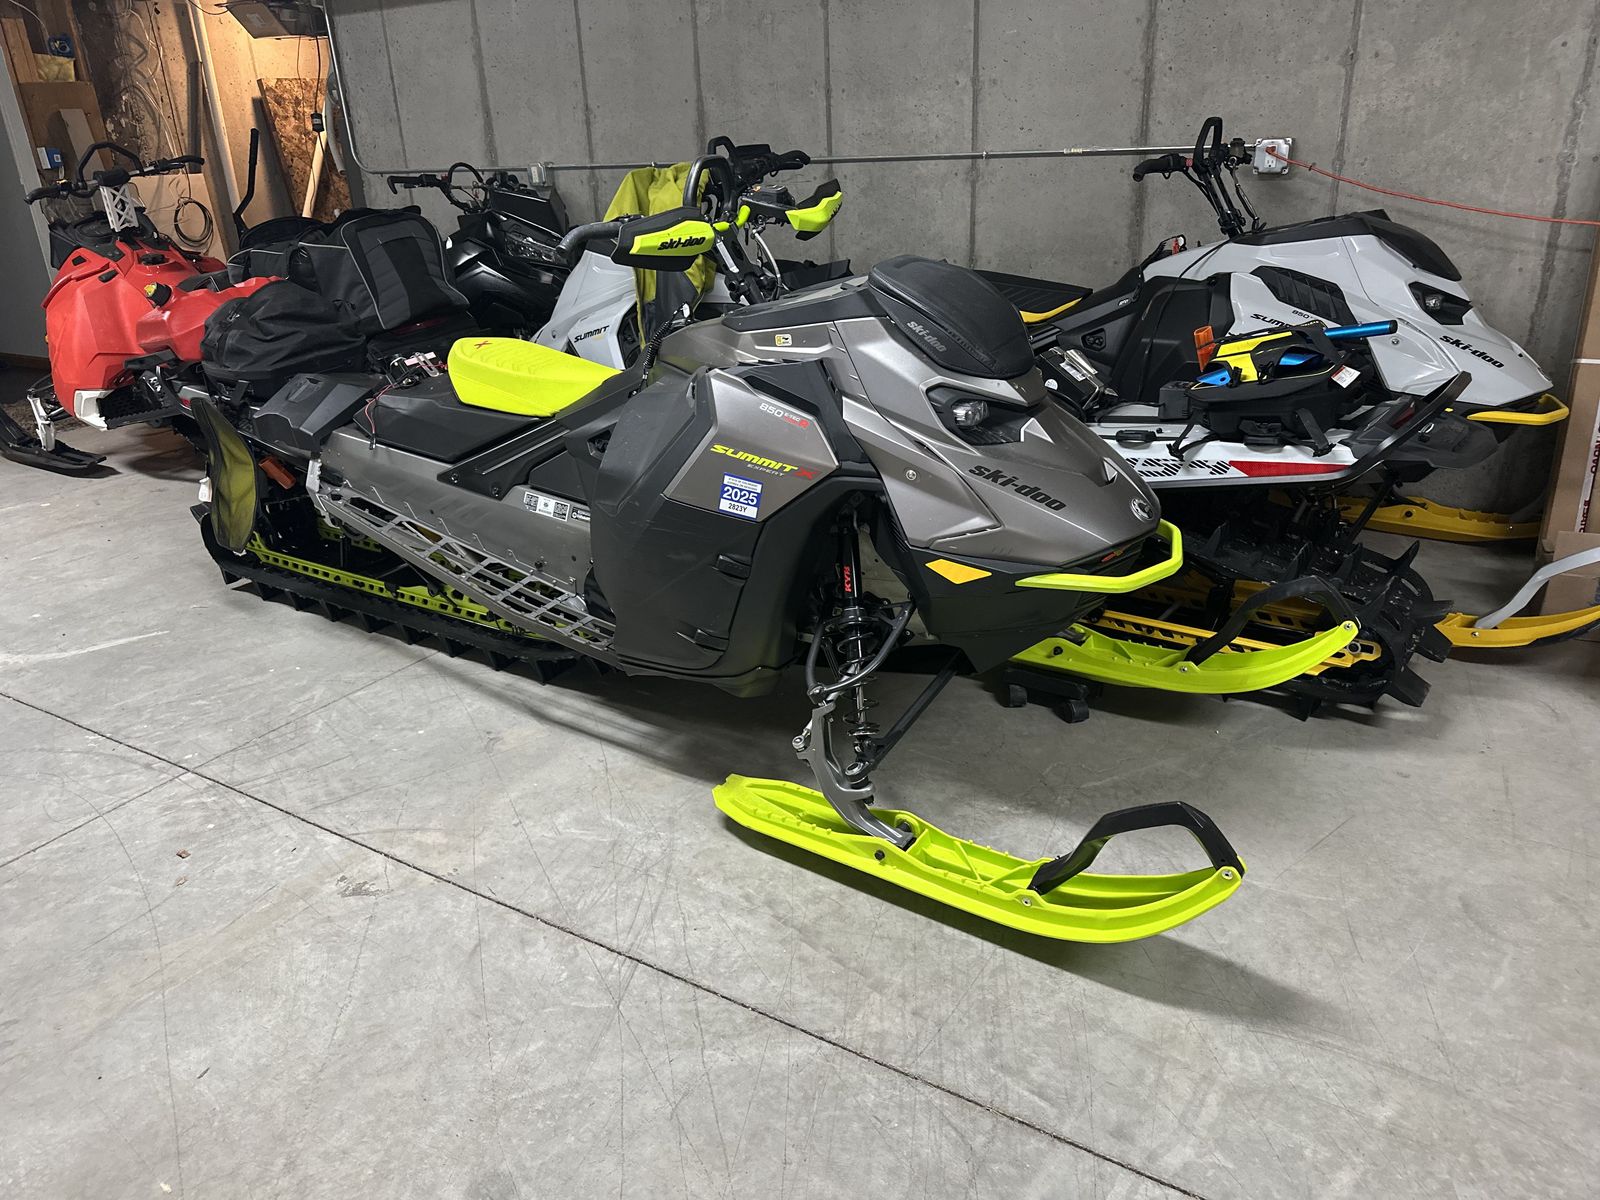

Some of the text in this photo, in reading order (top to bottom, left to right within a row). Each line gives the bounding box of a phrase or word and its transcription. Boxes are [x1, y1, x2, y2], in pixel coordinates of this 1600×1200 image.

[657, 236, 706, 251] ski-doo
[906, 321, 948, 353] ski-doo
[1439, 335, 1505, 369] ski-doo
[760, 402, 784, 418] 850
[710, 444, 799, 472] SUMMIT
[746, 463, 786, 477] EXPERT
[722, 486, 758, 506] 2025
[968, 465, 1067, 511] ski-doo
[728, 502, 748, 513] 2823Y
